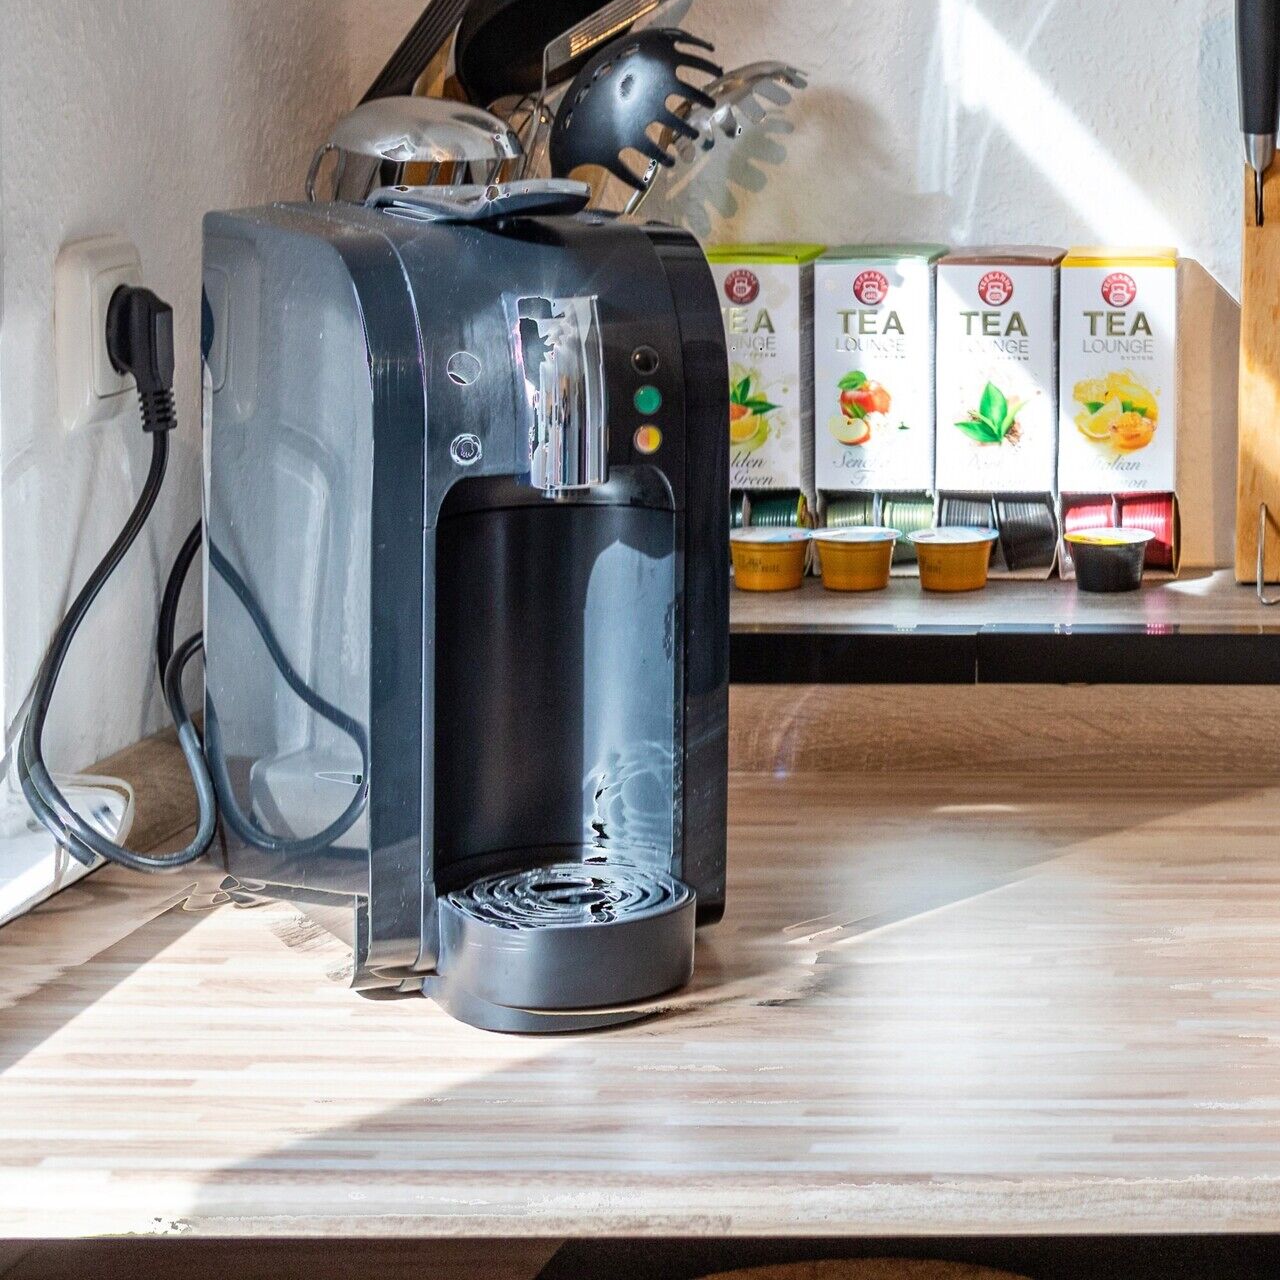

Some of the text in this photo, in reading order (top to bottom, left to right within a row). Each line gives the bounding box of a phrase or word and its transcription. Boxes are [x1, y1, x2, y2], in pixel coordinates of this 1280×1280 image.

[836, 309, 905, 335] TEA
[960, 311, 1029, 336] TEA
[1083, 311, 1153, 336] TEA
[835, 337, 905, 352] LOUNGE
[1083, 339, 1154, 354] LOUNGE
